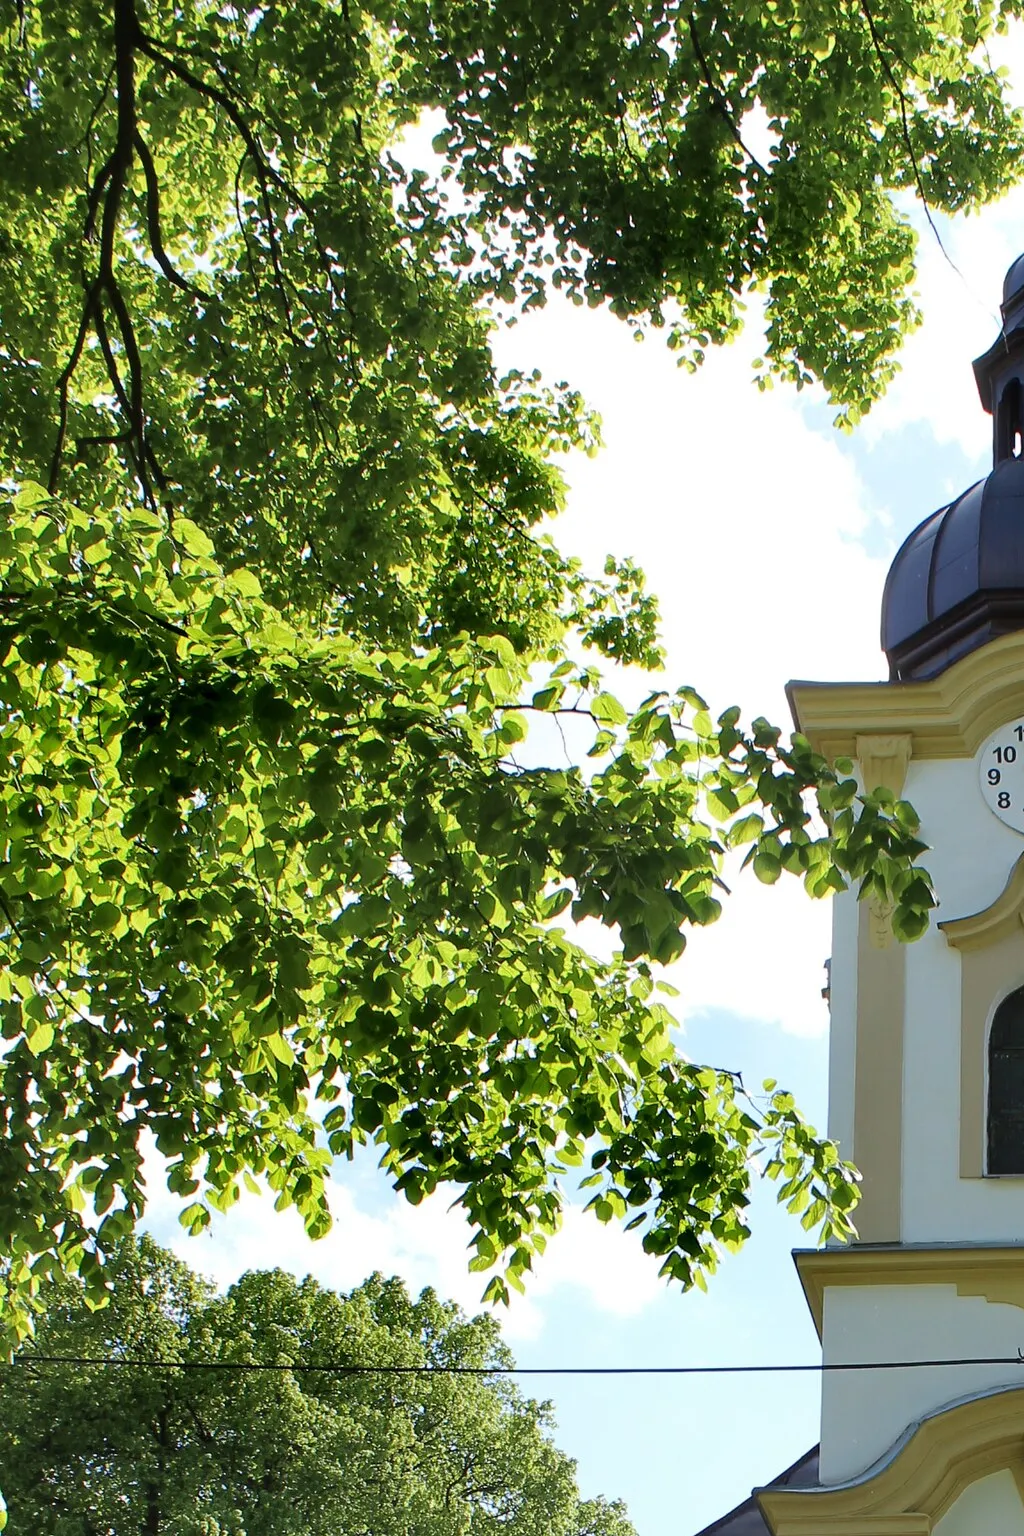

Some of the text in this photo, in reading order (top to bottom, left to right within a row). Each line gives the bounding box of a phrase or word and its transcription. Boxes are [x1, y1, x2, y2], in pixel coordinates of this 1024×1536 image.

[993, 746, 1016, 763] 10
[988, 769, 1000, 785] 9
[998, 792, 1010, 808] 8
